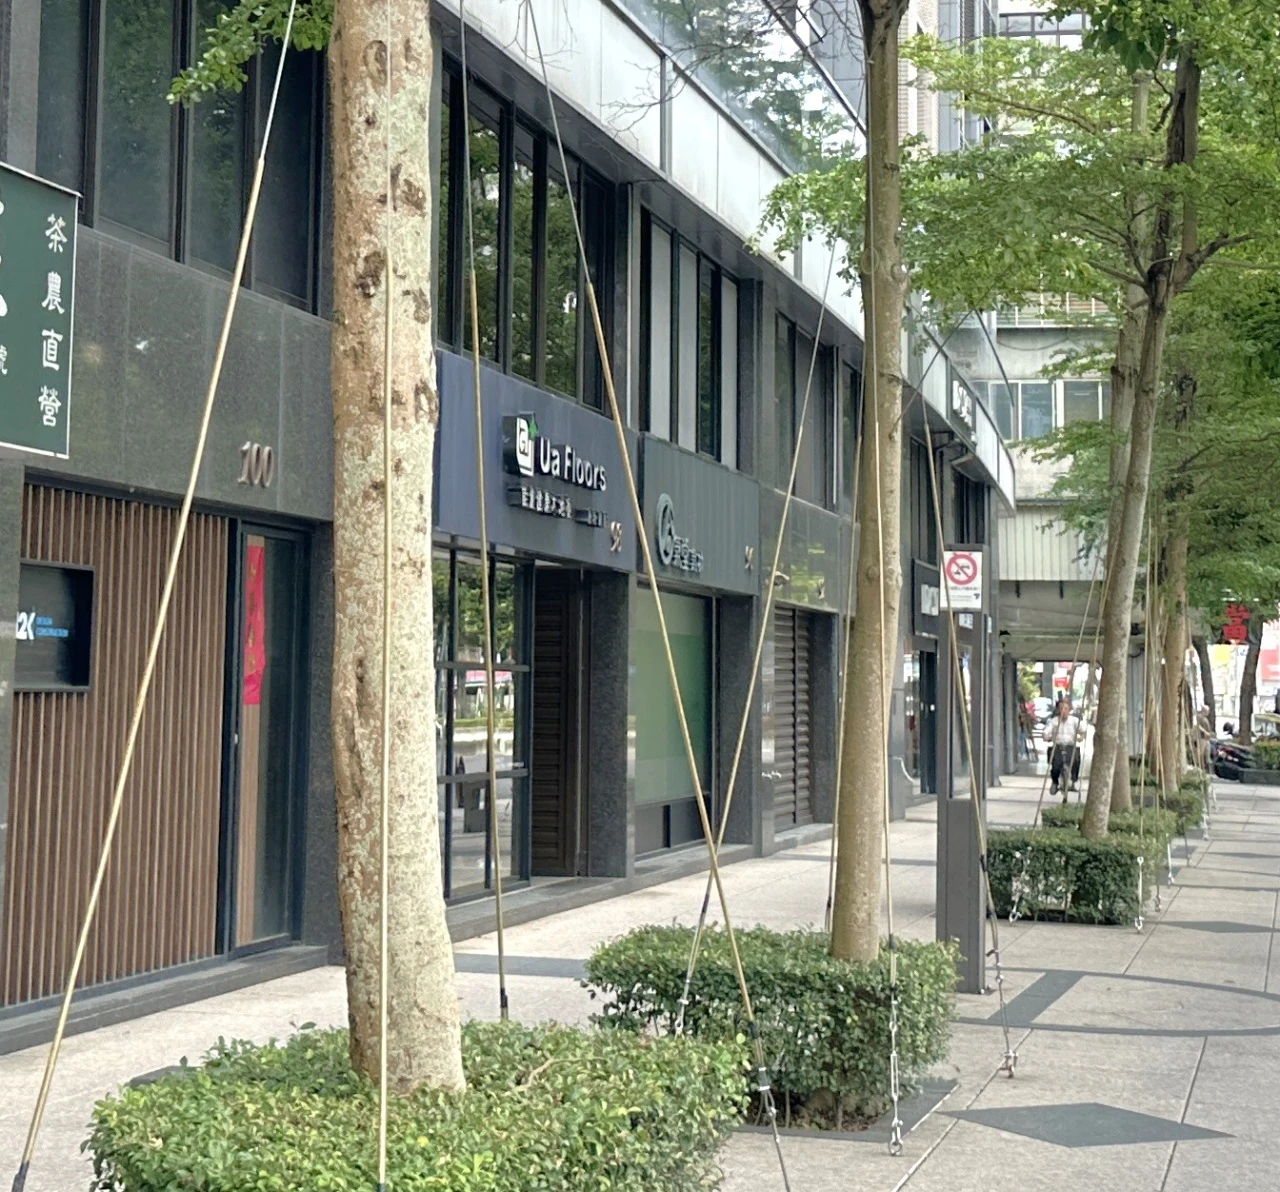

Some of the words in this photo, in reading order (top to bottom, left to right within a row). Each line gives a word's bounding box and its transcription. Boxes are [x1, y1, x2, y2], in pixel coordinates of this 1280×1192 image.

[37, 212, 70, 430] 茶農直營
[237, 441, 275, 489] 100
[540, 436, 561, 477] Ua
[564, 444, 607, 492] Floors
